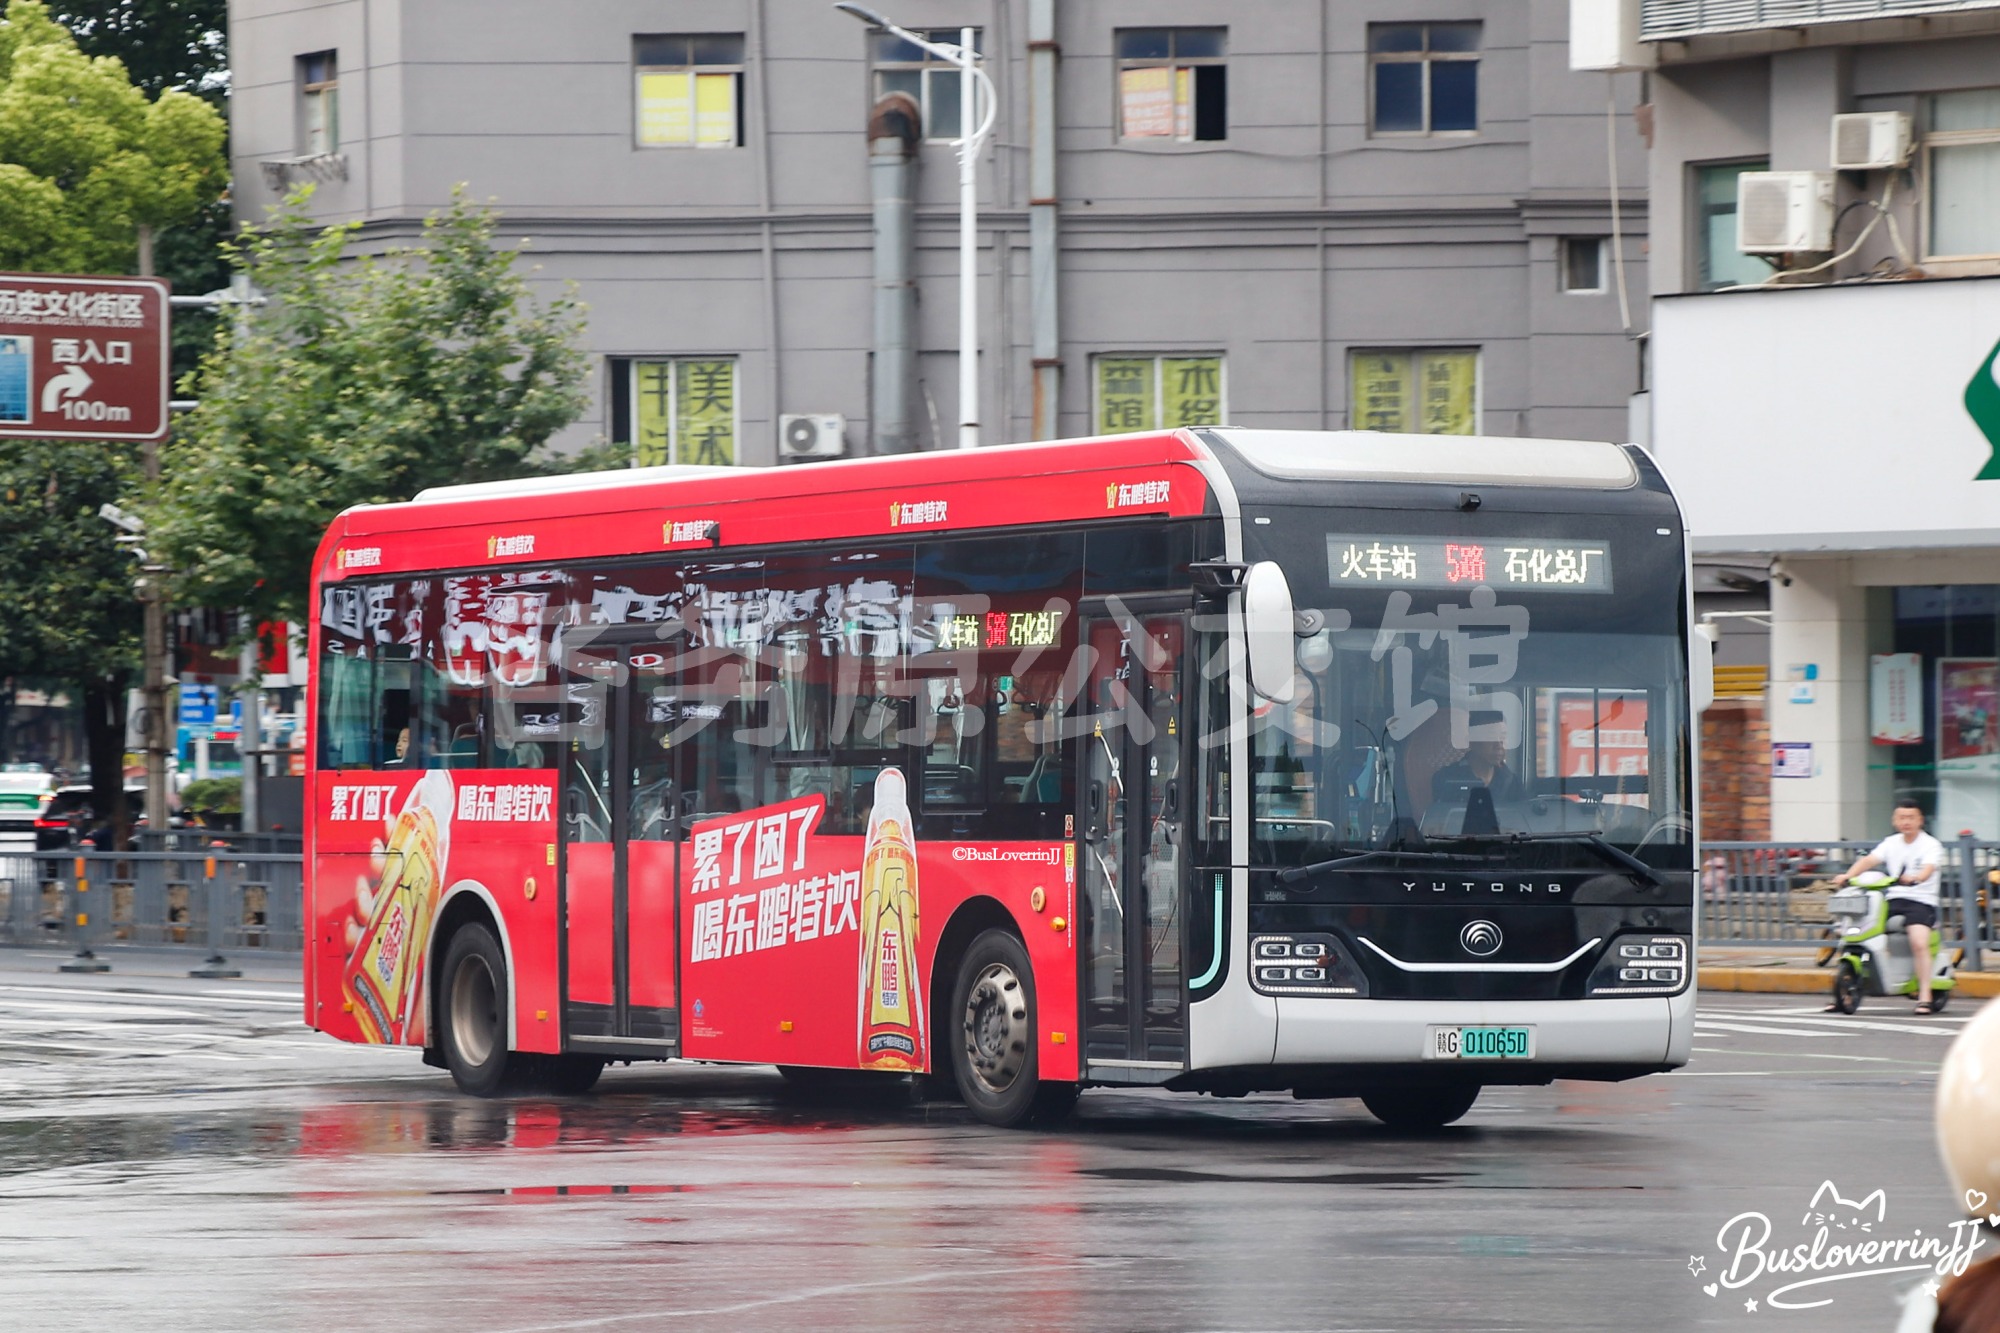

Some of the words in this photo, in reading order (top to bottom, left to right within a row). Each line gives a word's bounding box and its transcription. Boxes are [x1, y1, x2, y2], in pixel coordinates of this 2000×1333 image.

[52, 339, 131, 363] 西入口
[60, 401, 131, 421] 100m
[1118, 481, 1170, 506] 东鹏特饮
[901, 501, 947, 524] 东鹏特饮
[1340, 542, 1417, 581] 火车站
[1446, 544, 1485, 582] 5路
[1503, 547, 1604, 583] 石化总厂
[938, 615, 979, 650] 火车站
[986, 612, 1007, 649] 5路
[1009, 611, 1062, 645] 石化总厂
[330, 785, 398, 821] 累了困了
[457, 784, 552, 822] 喝东鹏特饮
[690, 804, 820, 895] 累了困了
[1402, 882, 1561, 893] YUTONG
[690, 869, 861, 963] 喝东鹏特饮
[882, 930, 897, 991] 东鹏
